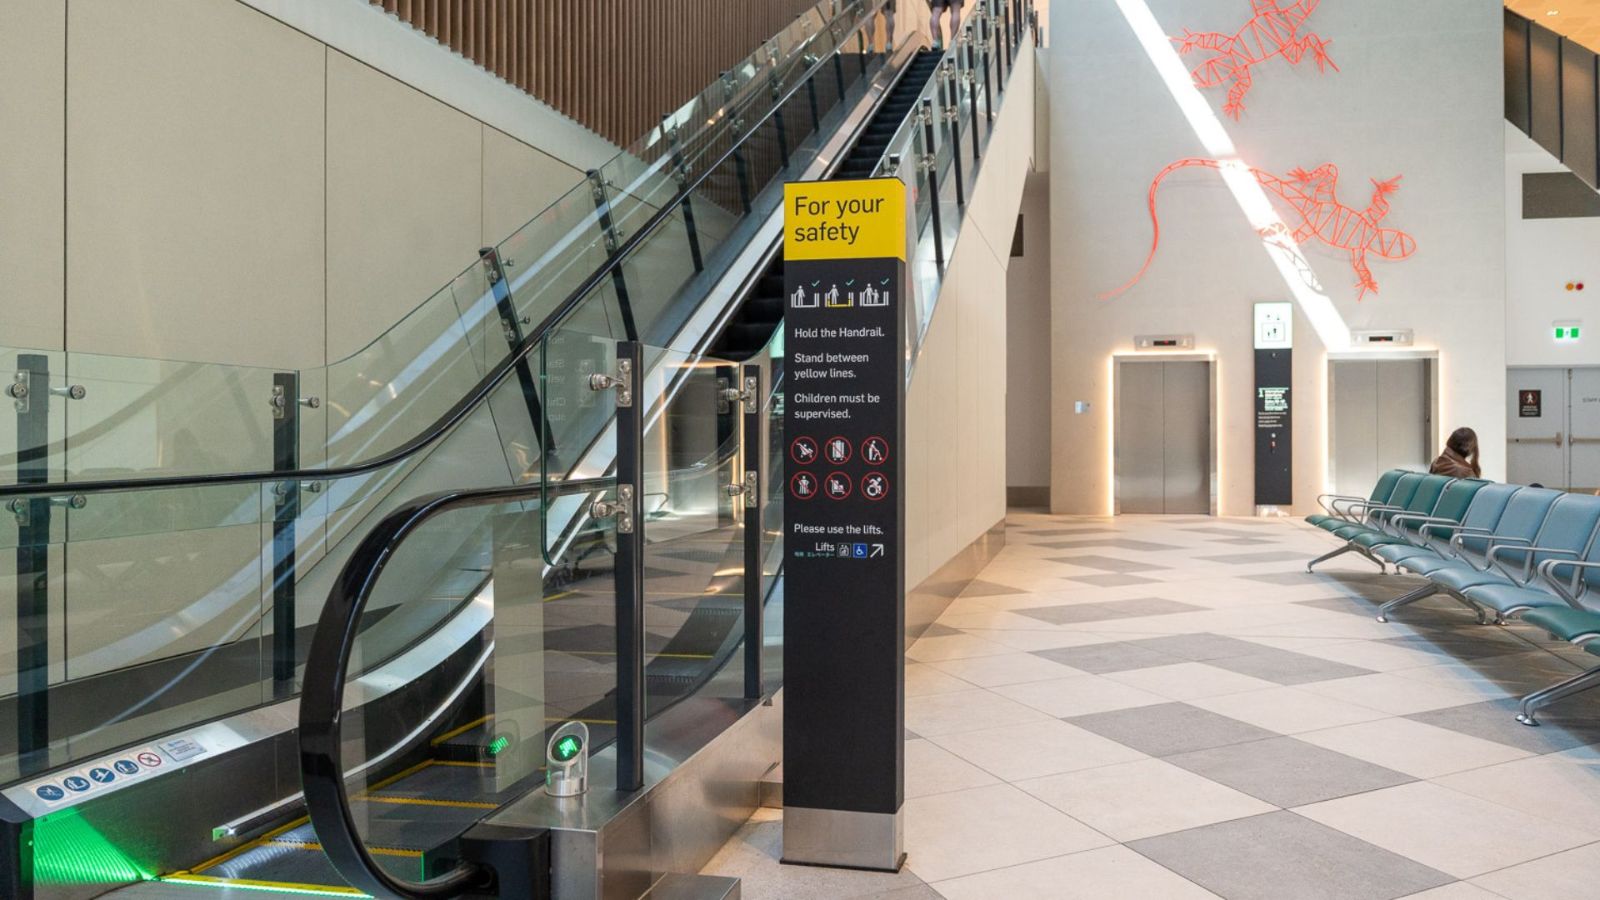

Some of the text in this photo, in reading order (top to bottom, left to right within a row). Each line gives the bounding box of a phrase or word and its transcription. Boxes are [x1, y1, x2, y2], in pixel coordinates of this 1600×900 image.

[795, 196, 884, 219] For your
[795, 221, 859, 245] safety
[794, 327, 885, 338] Hold the Handrail.
[794, 353, 869, 363] Stand between
[794, 368, 856, 380] yellow lines.
[794, 393, 880, 403] Children must be
[794, 409, 851, 420] supervised.
[794, 523, 884, 534] Please use the lifts.
[815, 542, 835, 551] Lifts
